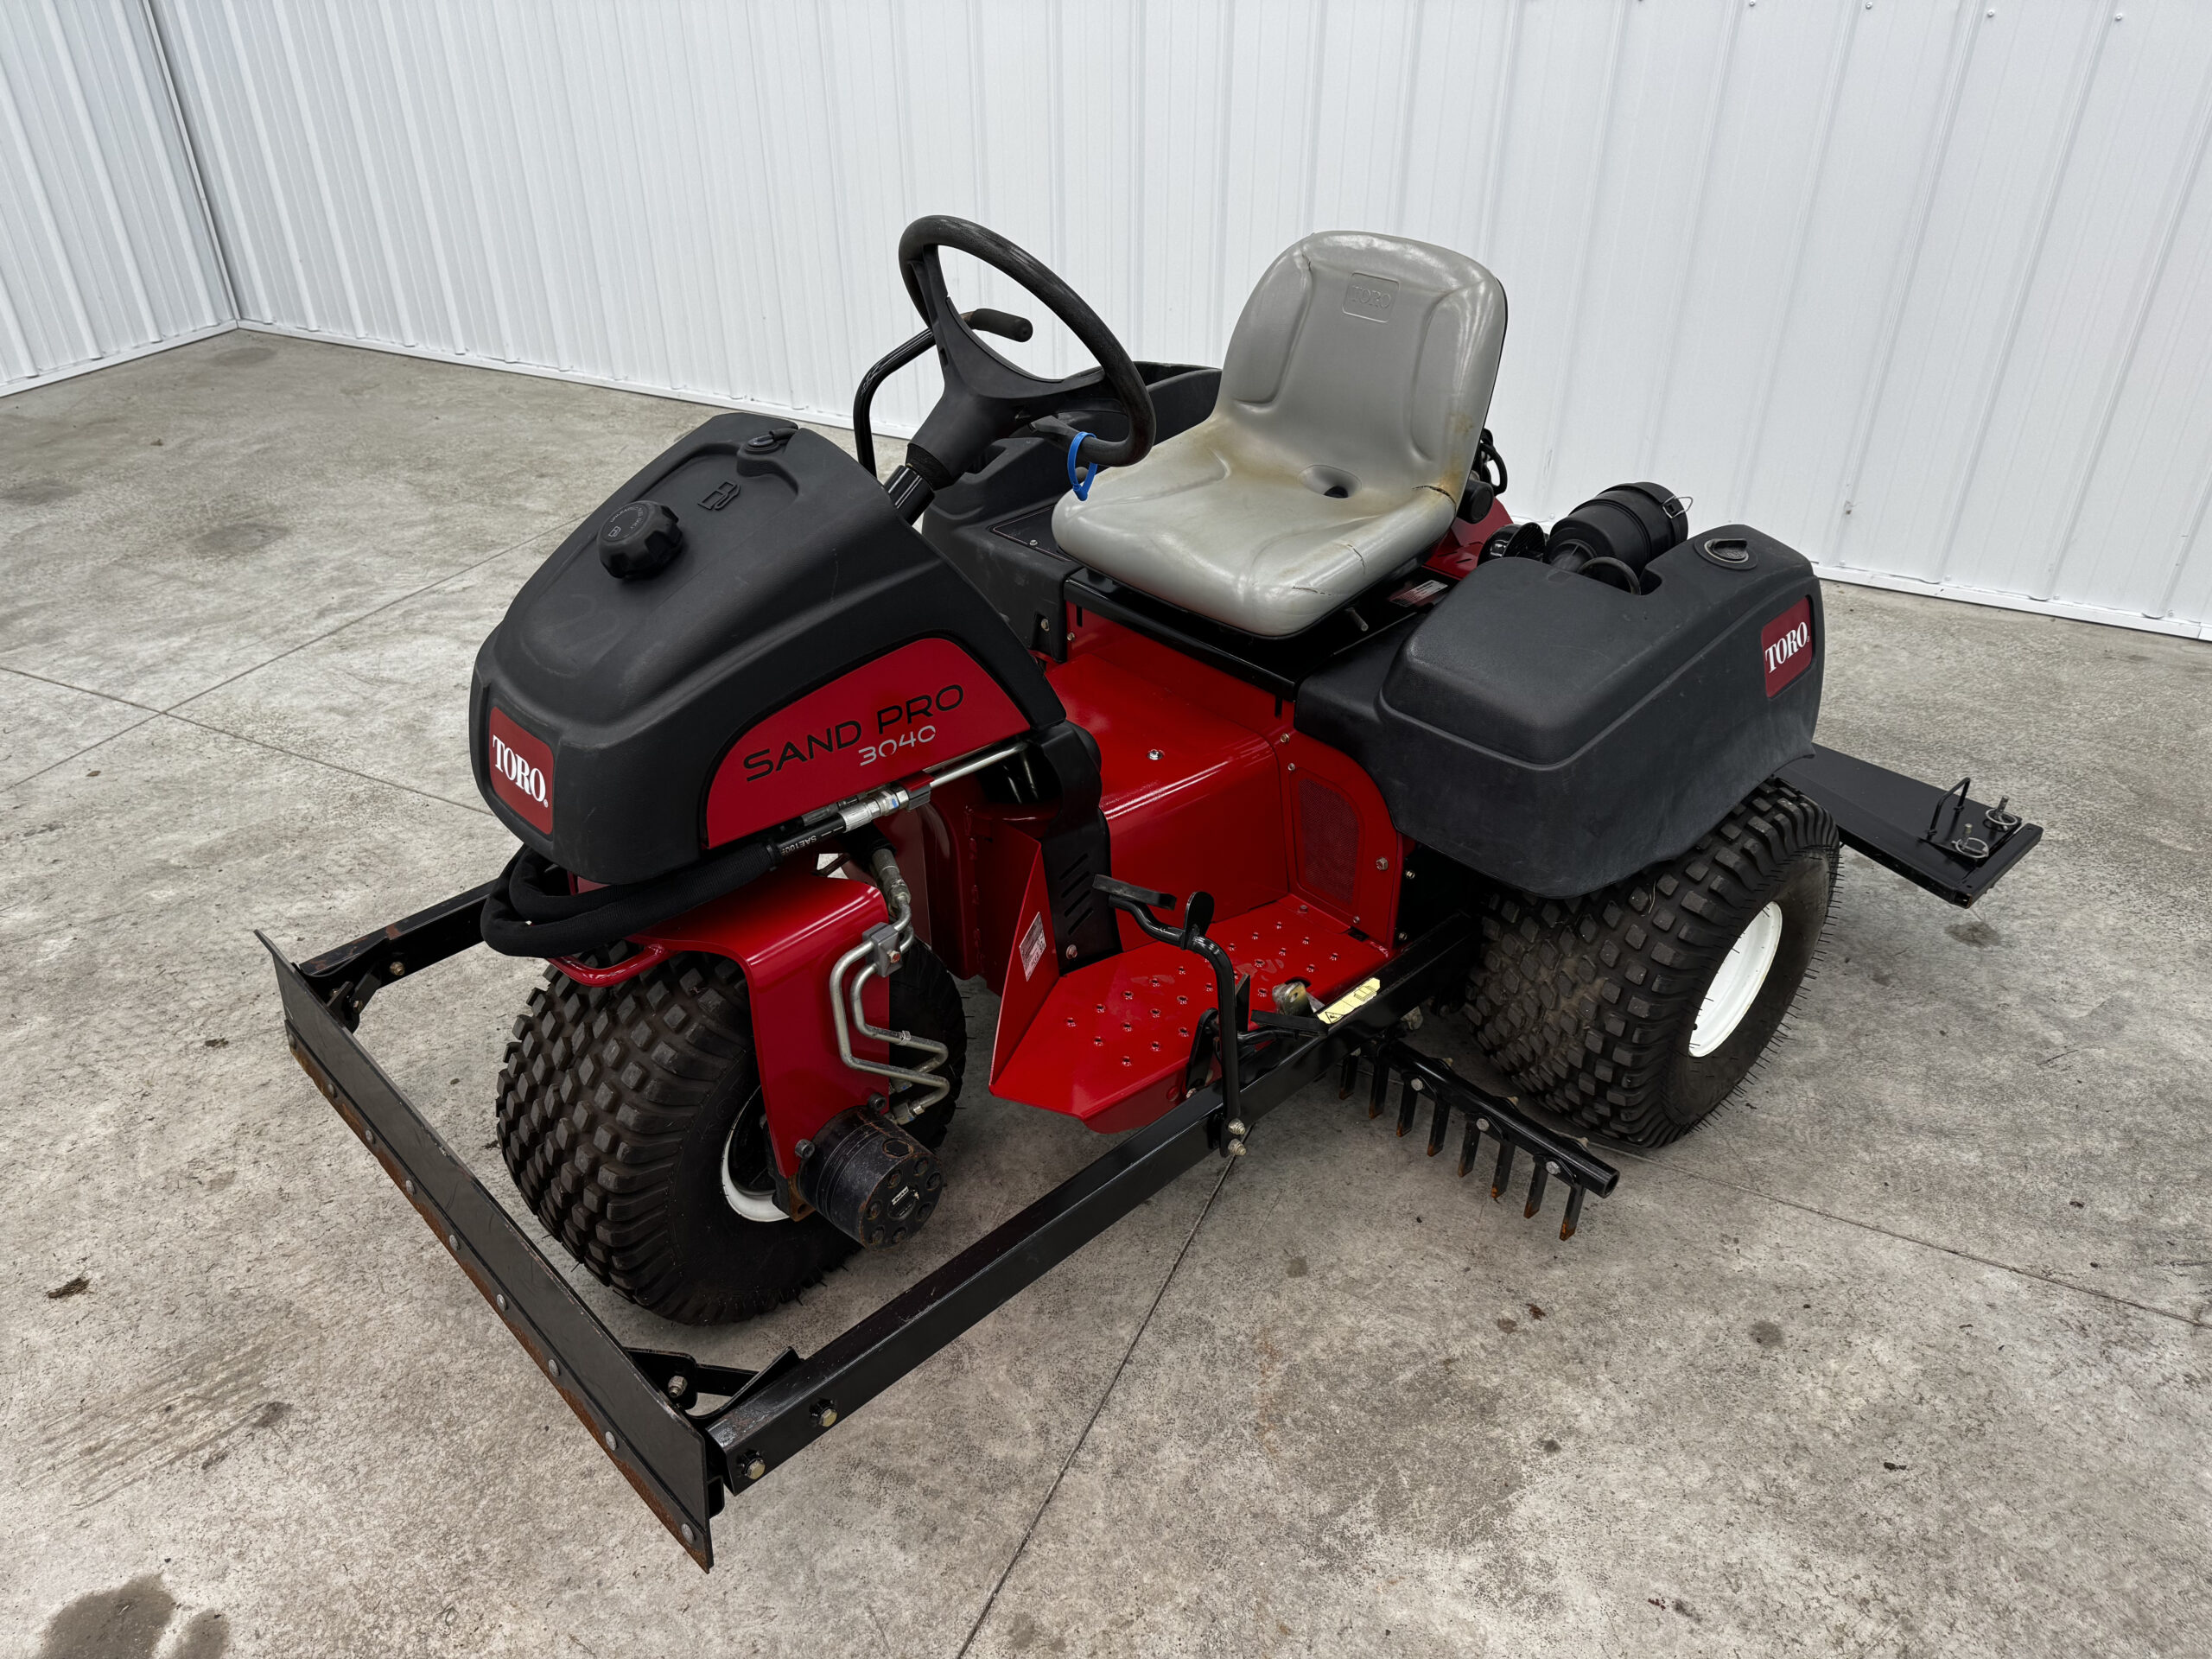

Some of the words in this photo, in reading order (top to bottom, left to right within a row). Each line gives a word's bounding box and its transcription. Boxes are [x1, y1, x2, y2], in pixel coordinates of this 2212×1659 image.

[1764, 621, 1808, 674] TORO
[743, 721, 861, 782] SAND
[877, 684, 963, 735] PRO
[858, 725, 937, 766] 3040
[493, 734, 546, 802] TORO
